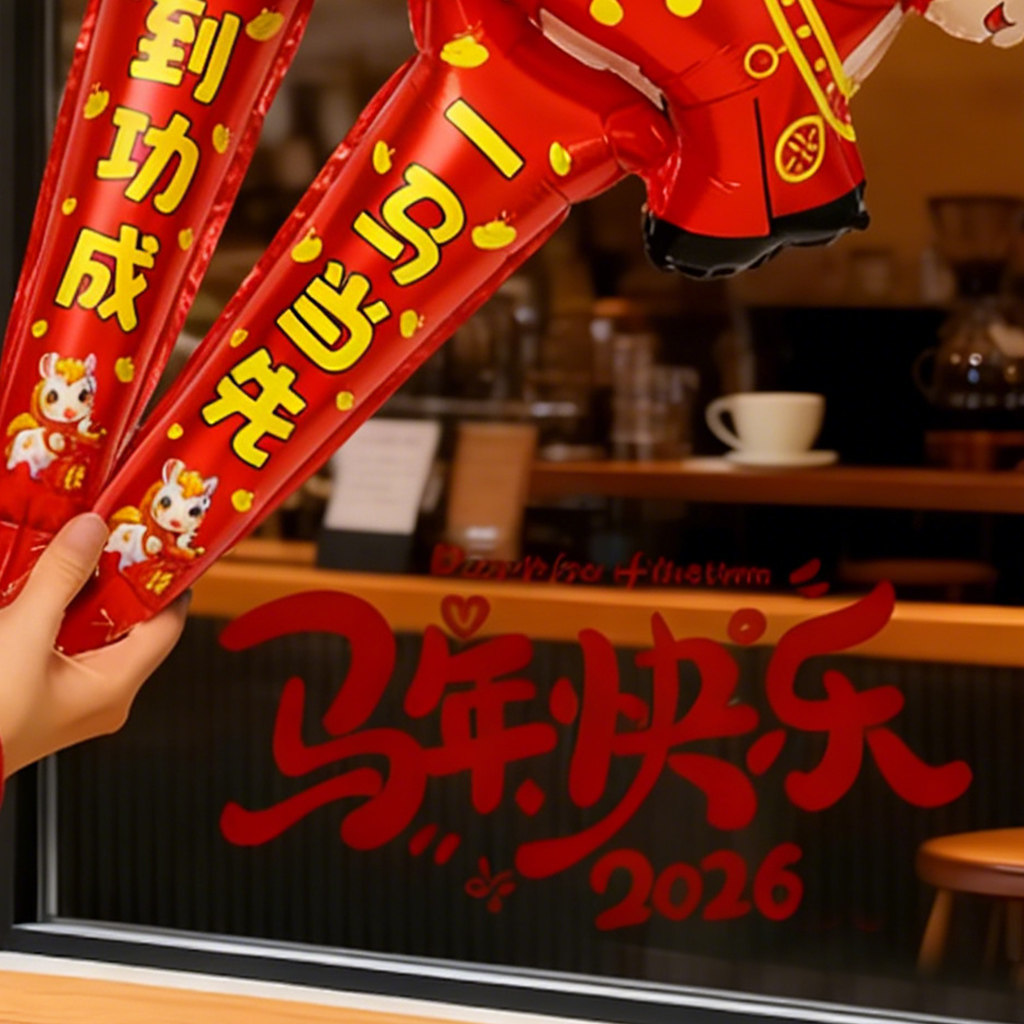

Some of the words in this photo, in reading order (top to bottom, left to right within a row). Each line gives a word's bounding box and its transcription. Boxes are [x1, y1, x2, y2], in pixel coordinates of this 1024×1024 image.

[201, 97, 525, 469] 一马当先
[219, 580, 972, 879] 马年快乐
[589, 842, 804, 932] 2026
